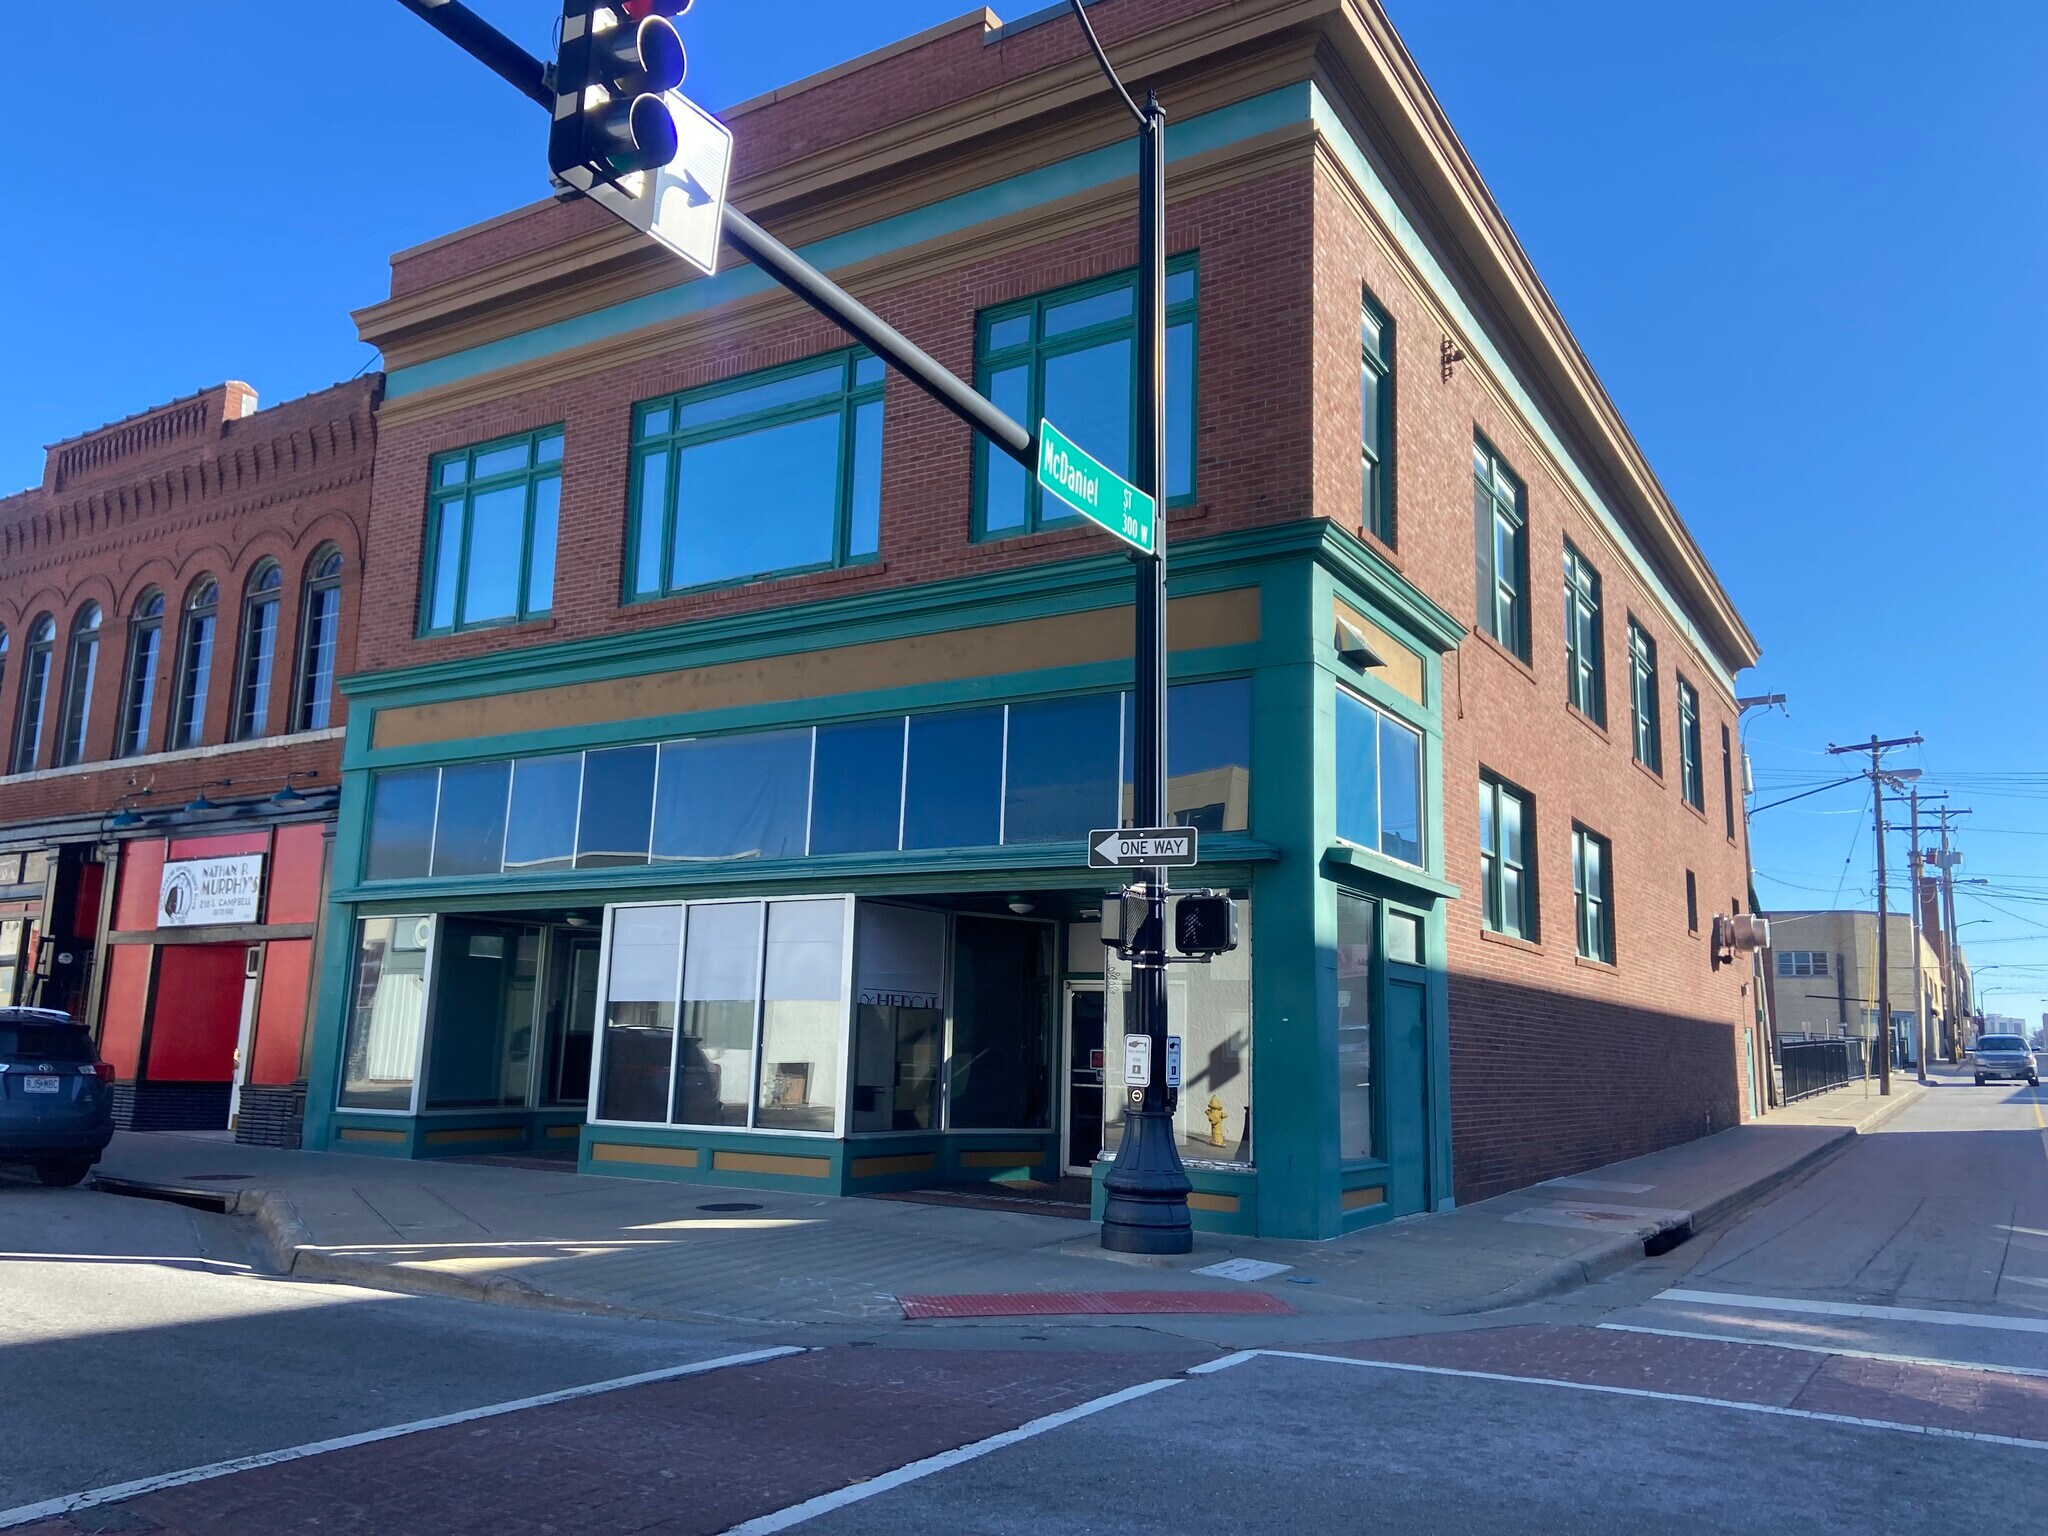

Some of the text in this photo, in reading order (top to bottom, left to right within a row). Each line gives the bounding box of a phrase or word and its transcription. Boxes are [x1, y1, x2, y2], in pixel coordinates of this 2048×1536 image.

[1044, 437, 1099, 507] McDaniel
[1123, 488, 1132, 510] ST
[1122, 512, 1149, 544] 300 W
[1120, 839, 1184, 855] ONE WAY
[202, 864, 238, 878] NATHAN
[200, 876, 258, 896] MURPHY'S
[218, 897, 251, 907] CAMPBELL
